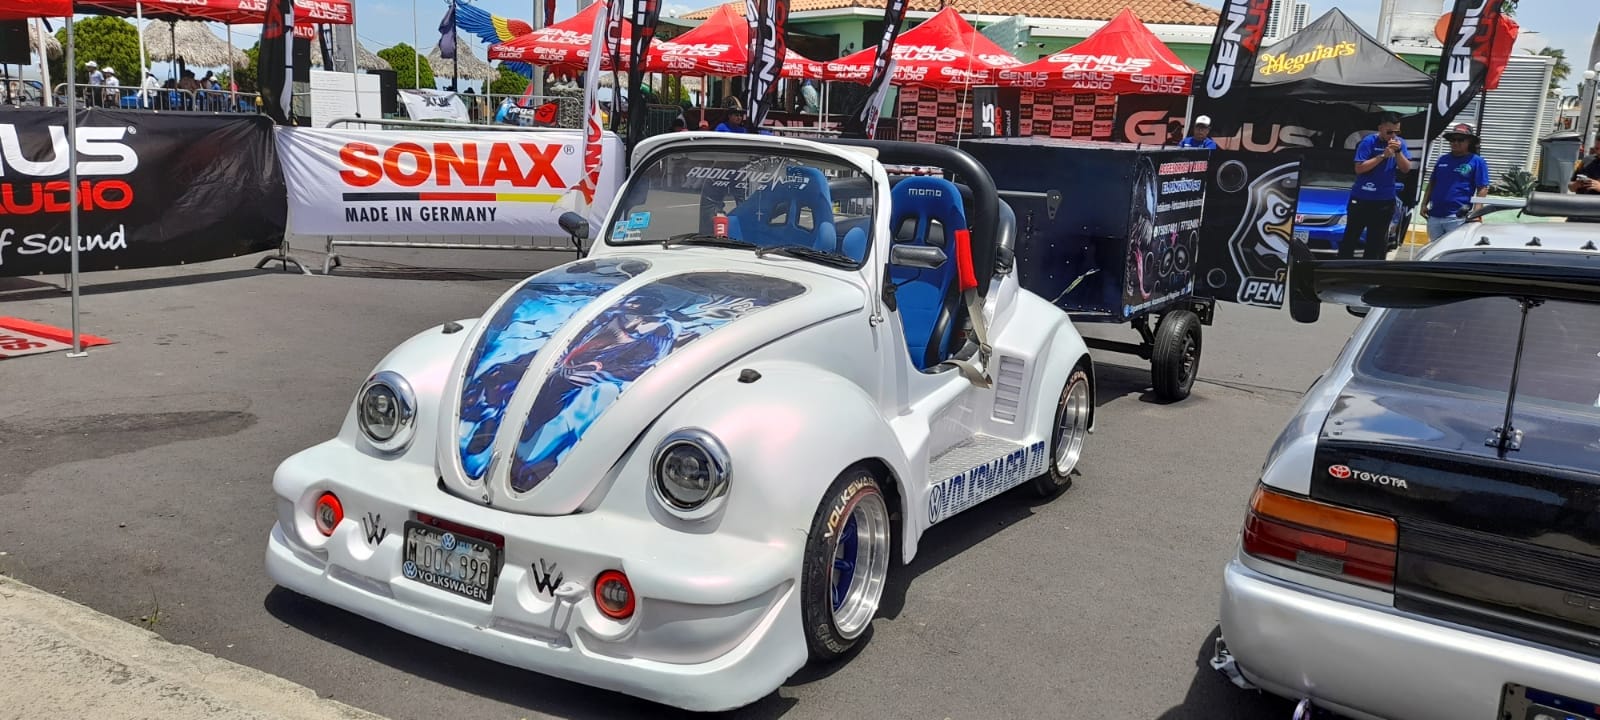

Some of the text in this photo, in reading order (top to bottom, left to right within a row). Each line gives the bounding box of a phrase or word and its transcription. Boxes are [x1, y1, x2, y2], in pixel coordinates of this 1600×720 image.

[1047, 53, 1153, 68] GENIUS
[1260, 41, 1355, 76] Meguiar's
[827, 63, 871, 73] GENIUS
[893, 65, 928, 74] ENIUS
[1060, 62, 1144, 73] AUDIO
[998, 69, 1049, 81] GENIUS
[1062, 70, 1115, 82] GENIUS
[1129, 73, 1186, 86] GENIUS
[1010, 79, 1047, 88] AUDIO
[1072, 80, 1113, 90] AUDIO
[1140, 84, 1183, 94] AUDIO
[339, 142, 567, 188] SONAX
[345, 206, 498, 223] MADE IN GERMANY
[1352, 469, 1408, 489] TOYOTA
[417, 569, 488, 600] VOLKSWAGEN
